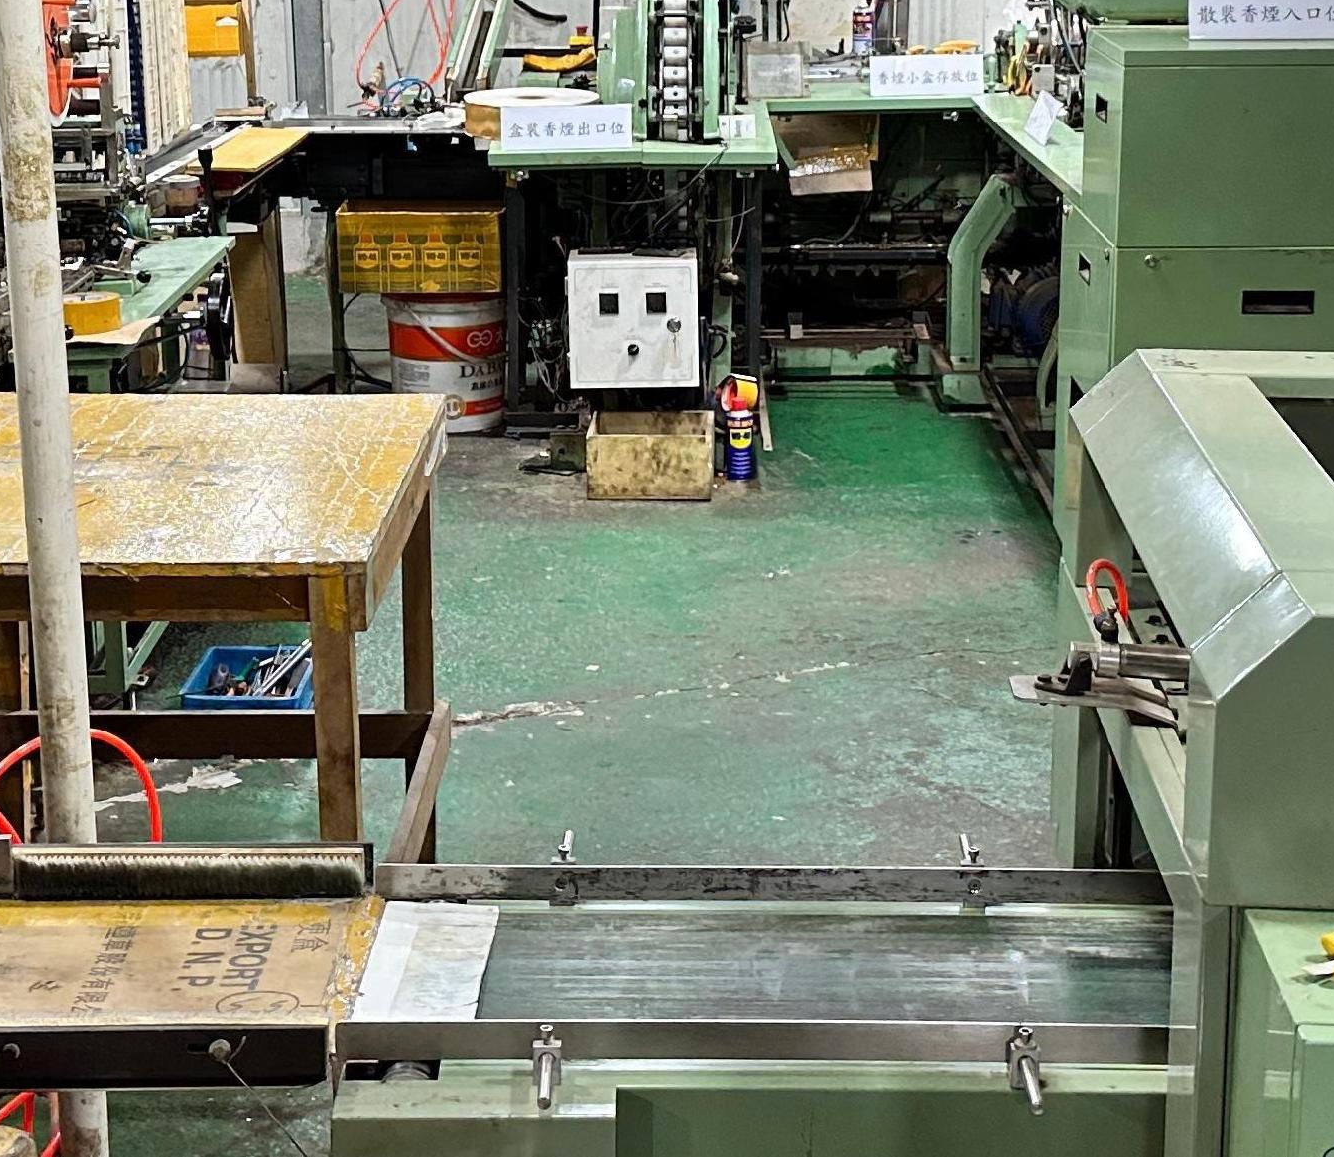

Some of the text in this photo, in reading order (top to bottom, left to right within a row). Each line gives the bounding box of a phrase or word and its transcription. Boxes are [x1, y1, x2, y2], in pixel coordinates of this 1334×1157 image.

[878, 70, 979, 85] 香煙小盒存放位
[508, 121, 625, 138] 盒裝香煙出口位
